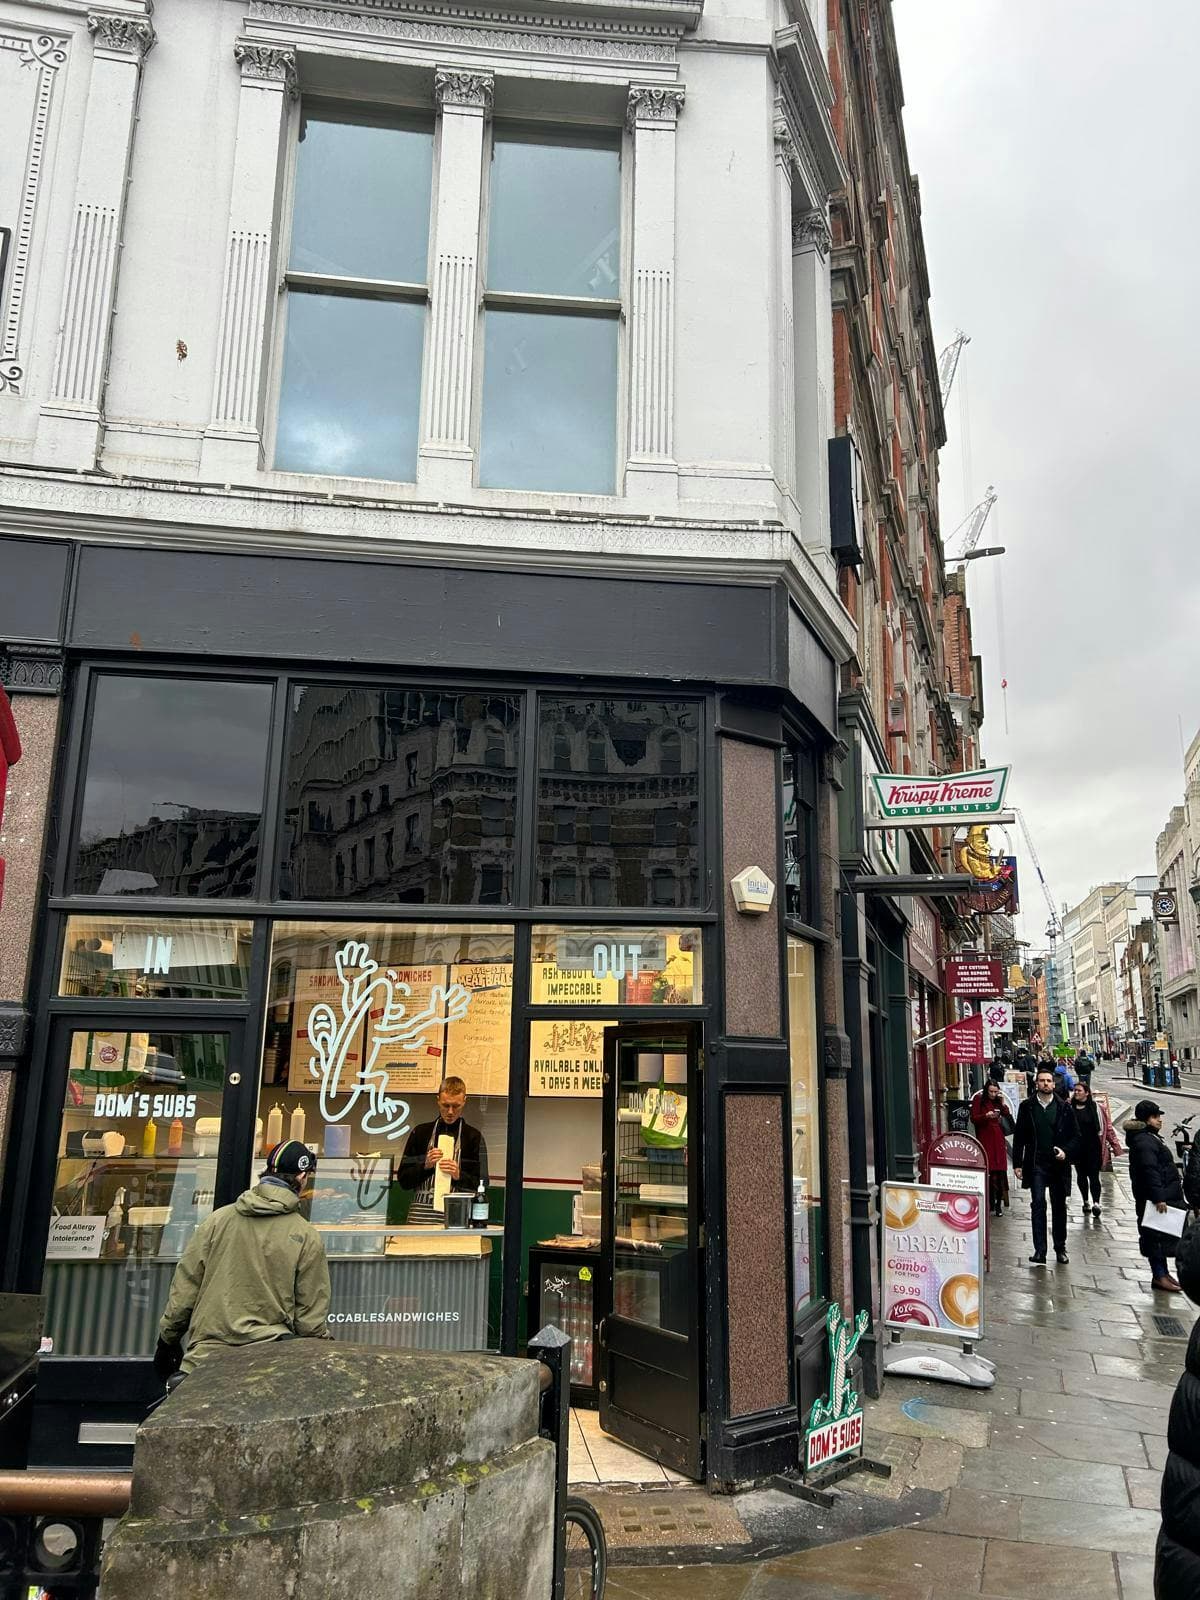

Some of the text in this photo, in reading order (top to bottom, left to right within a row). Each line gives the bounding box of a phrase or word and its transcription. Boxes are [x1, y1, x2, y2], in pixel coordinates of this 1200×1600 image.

[888, 779, 995, 805] Krispy Kreme
[890, 804, 990, 815] DOUGHNUTS
[748, 878, 768, 888] Initial
[144, 936, 172, 974] IN
[593, 944, 642, 980] OUT
[384, 970, 432, 982] SDWICHES
[542, 967, 559, 980] ASK
[310, 975, 354, 987] SANDWICES
[547, 982, 602, 996] IMPECCABLE
[534, 1060, 603, 1073] AVAILABLE ONL
[548, 1077, 571, 1089] DAYS
[573, 1077, 579, 1089] A
[582, 1077, 603, 1089] WEE
[94, 1091, 197, 1118] DOM'S SUBS
[934, 1140, 980, 1157] TIMPSON
[893, 1234, 967, 1255] TREAT
[888, 1259, 927, 1273] Combo
[893, 1285, 921, 1296] £9.99
[326, 1312, 460, 1323] CCABLESANDWICHES
[810, 1417, 862, 1465] DOM'S SUBS
